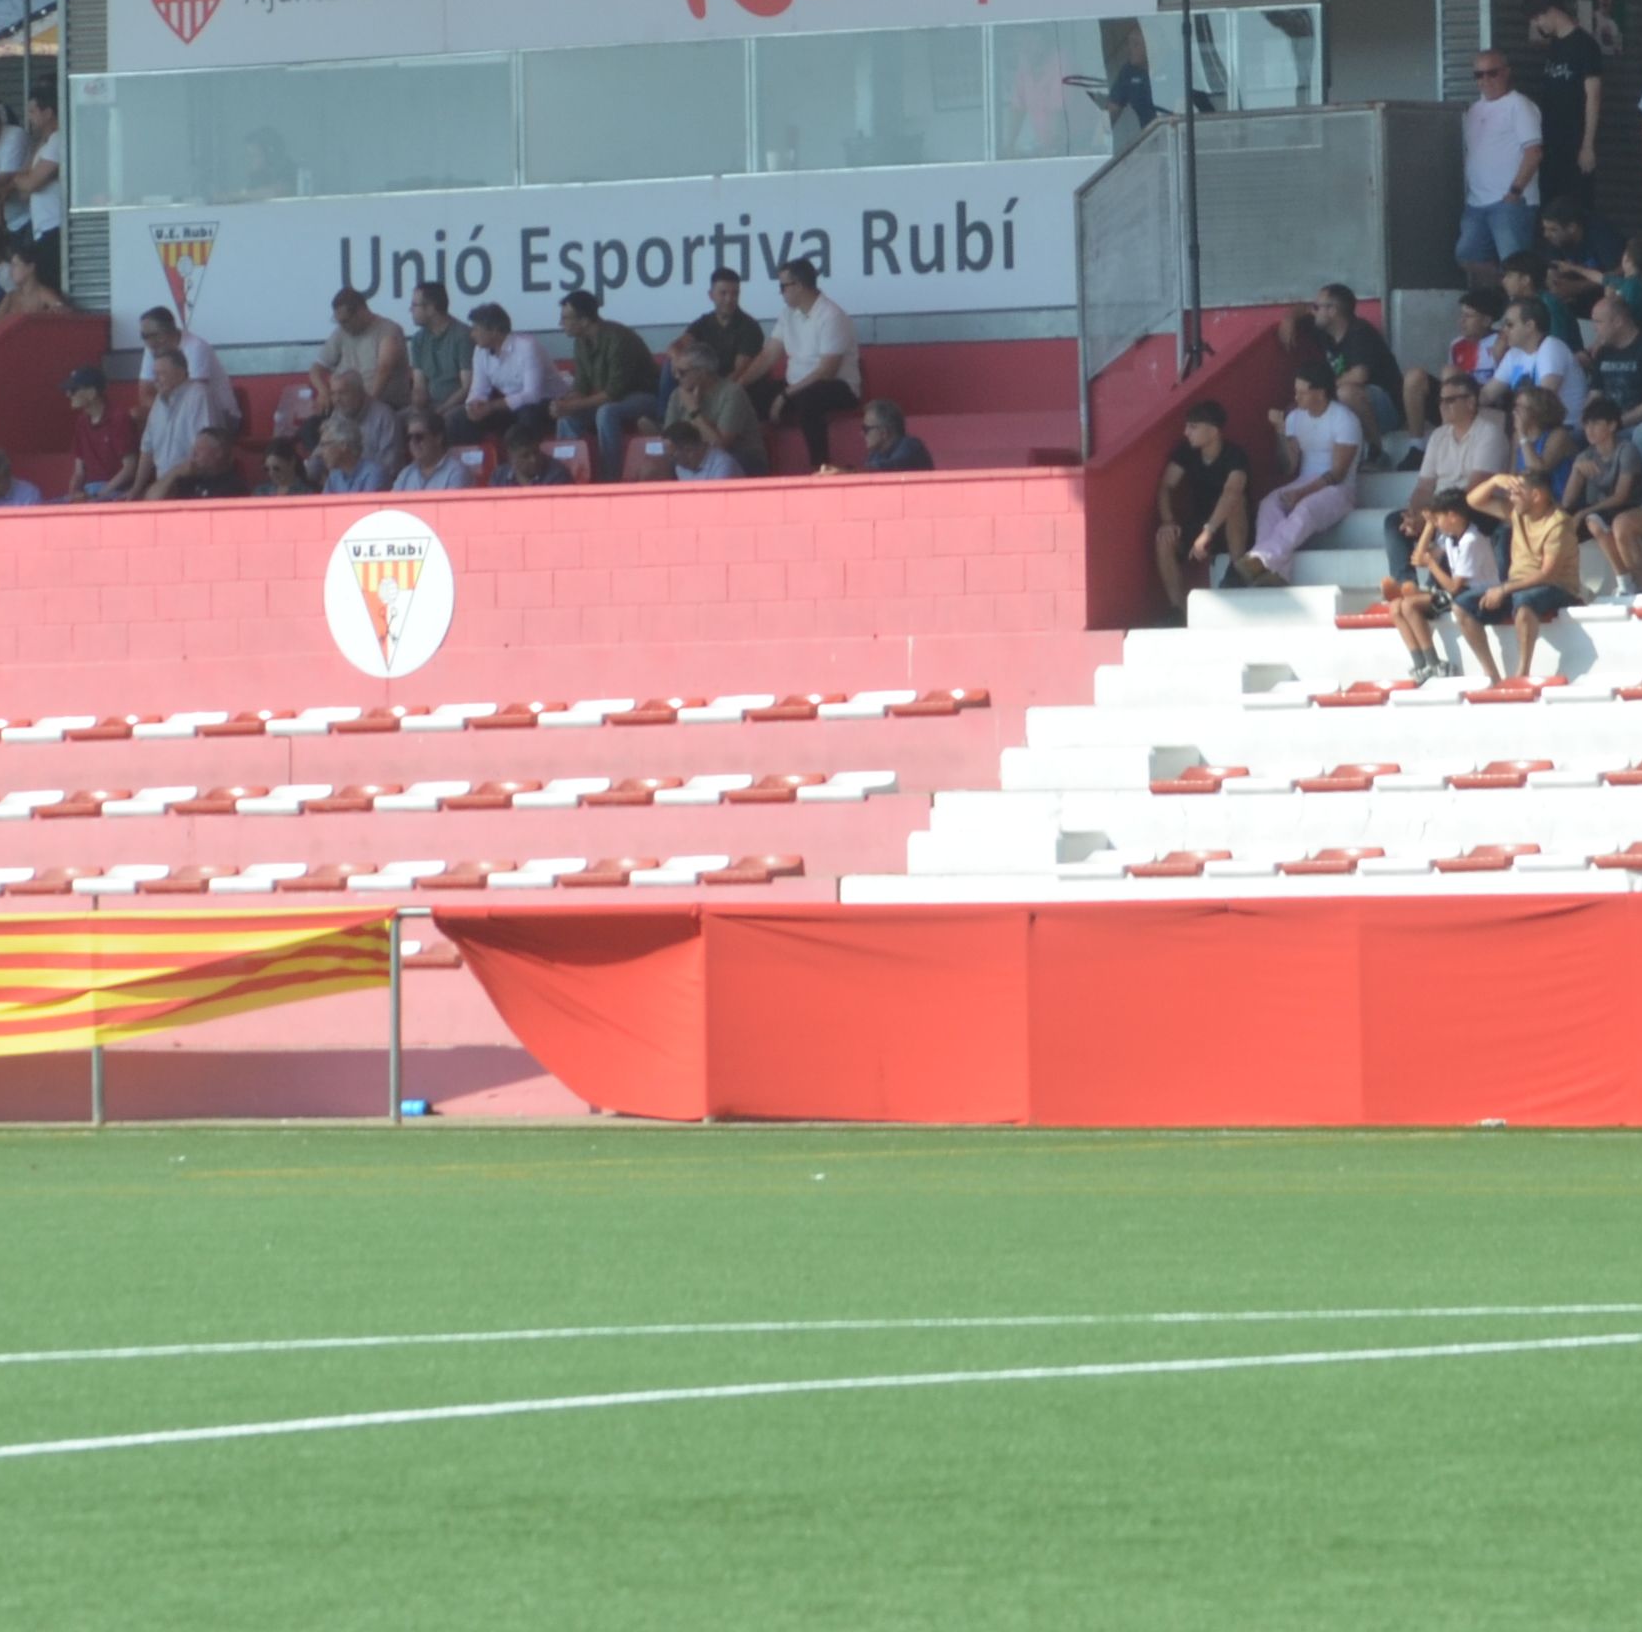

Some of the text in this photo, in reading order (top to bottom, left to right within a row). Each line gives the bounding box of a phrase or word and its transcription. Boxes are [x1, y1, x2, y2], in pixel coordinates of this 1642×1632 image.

[340, 196, 1020, 307] Unió Esportiva Rubí
[352, 544, 382, 558] U.E.
